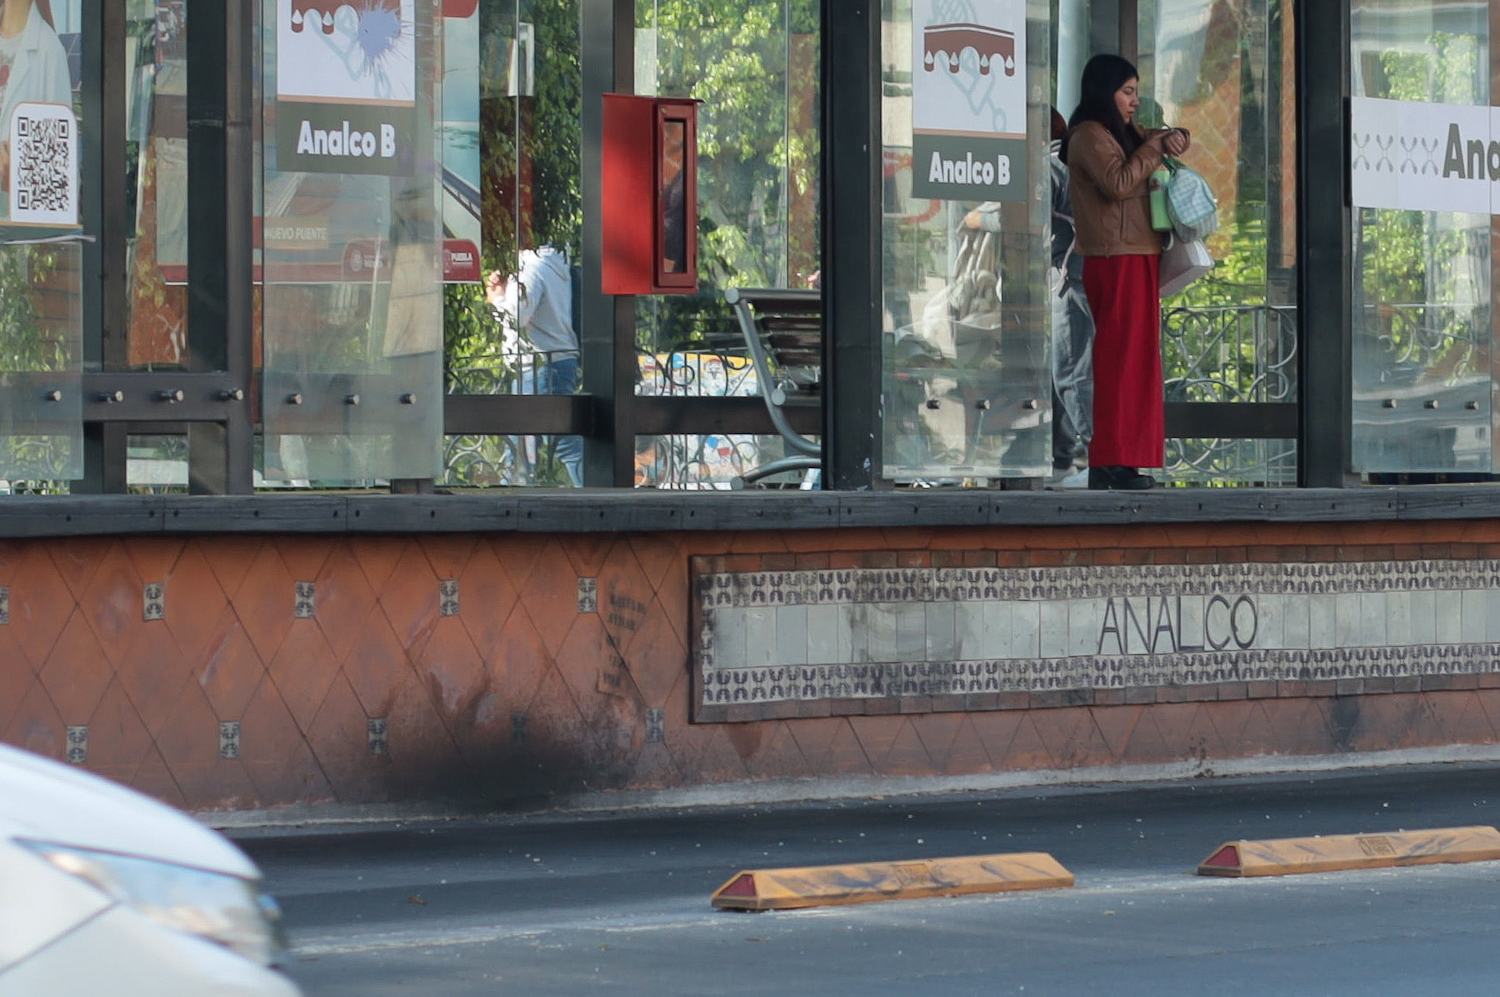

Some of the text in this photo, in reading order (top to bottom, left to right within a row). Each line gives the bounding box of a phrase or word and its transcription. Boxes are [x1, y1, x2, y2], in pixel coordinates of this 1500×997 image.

[297, 120, 396, 158] Analco B
[928, 151, 1011, 185] Analco B
[1098, 594, 1258, 654] ANALCO
